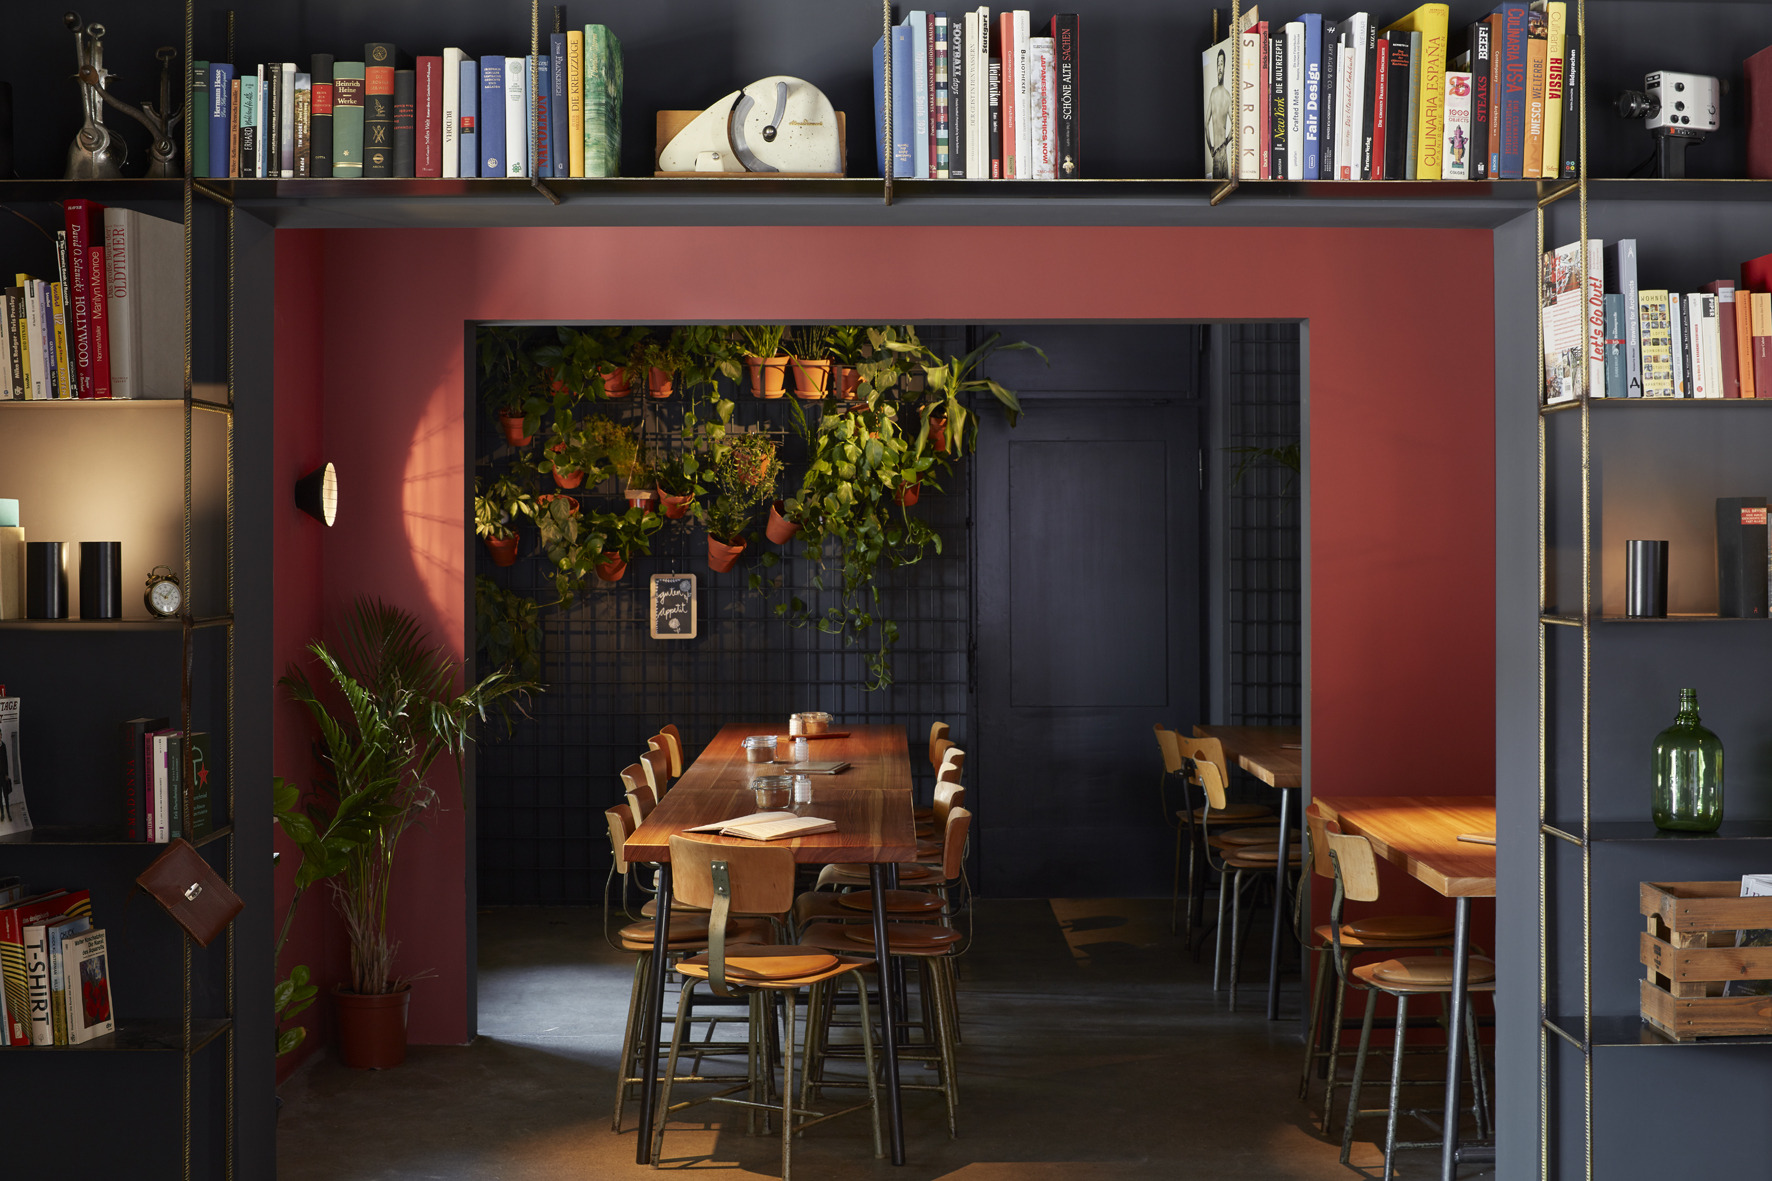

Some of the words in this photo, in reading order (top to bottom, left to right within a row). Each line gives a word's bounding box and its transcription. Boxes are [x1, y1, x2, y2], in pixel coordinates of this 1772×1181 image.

[953, 23, 962, 78] FOOTBALL
[1062, 28, 1071, 61] SACHEN
[1276, 39, 1284, 81] KULTREZEPTE
[1478, 26, 1488, 60] BEEF!
[555, 56, 564, 97] FRANKREICH
[569, 39, 580, 94] KREUZZÜGE
[1062, 63, 1071, 84] ALTE
[1426, 36, 1440, 91] ESPAÑA
[1532, 58, 1543, 100] WELTERBE
[1548, 57, 1563, 100] RUSSIA
[951, 78, 961, 96] days
[988, 63, 1001, 106] Weinlexikon
[1276, 82, 1284, 96] DIE
[1291, 88, 1299, 106] Meat
[1306, 62, 1321, 111] Design
[1477, 76, 1487, 122] STEAKS
[213, 88, 221, 118] Hermann
[570, 98, 580, 113] DIE
[916, 95, 926, 117] Spiele
[1061, 85, 1071, 120] SCHÖNE
[1275, 96, 1286, 119] York
[1531, 101, 1542, 135] UNESCO
[445, 110, 453, 144] BUDDHA
[538, 96, 549, 168] NAPOLEON
[1274, 119, 1286, 145] New
[1291, 107, 1299, 137] Crafted
[1306, 114, 1318, 142] Fair
[1424, 96, 1438, 167] CULINARIA
[243, 128, 253, 151] ERHARD
[71, 224, 82, 248] David
[73, 257, 85, 292] Selznick's
[90, 251, 101, 286] Monroe
[112, 228, 127, 298] OLDTIMER
[92, 286, 104, 320] Marilyn
[1588, 276, 1604, 306] Out!
[53, 313, 63, 325] U2
[74, 296, 89, 368] HOLLYWOOD
[1589, 309, 1604, 327] Go
[1630, 323, 1638, 346] Drawing
[1590, 329, 1604, 362] Let's
[126, 759, 136, 826] MADONNA
[26, 939, 50, 1026] T-SHIRT
